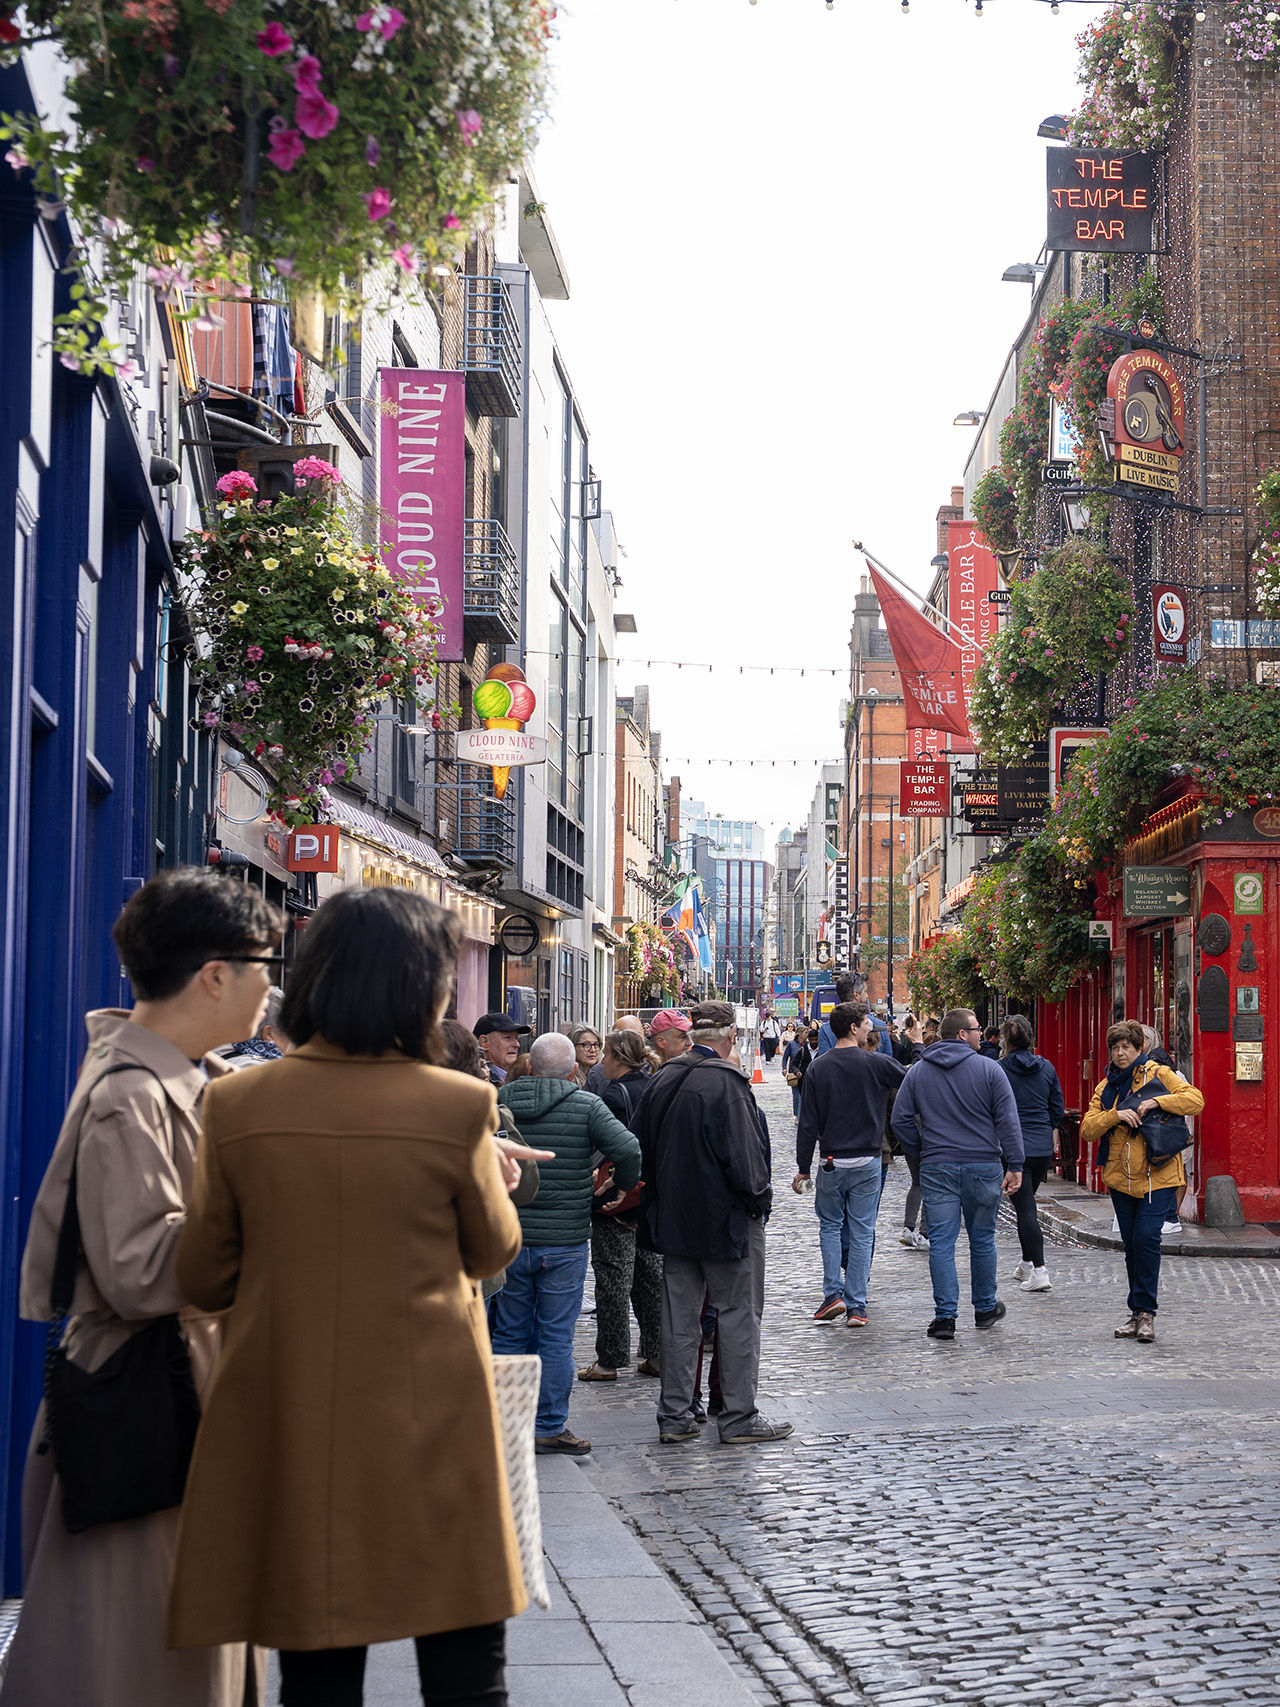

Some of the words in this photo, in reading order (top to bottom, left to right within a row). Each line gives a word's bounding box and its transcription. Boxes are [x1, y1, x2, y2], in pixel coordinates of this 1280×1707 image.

[1075, 158, 1123, 180] THE
[1051, 188, 1147, 208] TEMPLE
[1075, 219, 1125, 240] BAR
[1118, 369, 1130, 403] THE
[1127, 356, 1171, 381] TEMPLE
[1170, 382, 1182, 416] BAR
[397, 382, 448, 475] NINE
[1133, 449, 1168, 467] DUBLIN
[1126, 468, 1146, 482] LIVE
[1149, 474, 1175, 490] MUSIC
[959, 555, 975, 593] BAR
[990, 591, 1011, 601] GUIN
[1159, 641, 1184, 651] GUINNESS
[469, 734, 505, 748] CLOUD
[509, 736, 535, 750] NINE
[478, 752, 525, 761] GELATERIA
[915, 765, 935, 773] THE
[905, 775, 945, 784] TEMPLE
[913, 786, 935, 794] BAR
[959, 783, 976, 791] THE
[965, 792, 998, 805] WHISKE
[1016, 801, 1044, 809] DAILY
[1128, 874, 1137, 882] The
[1136, 872, 1164, 885] Whiskey
[1164, 873, 1188, 885] Reserve
